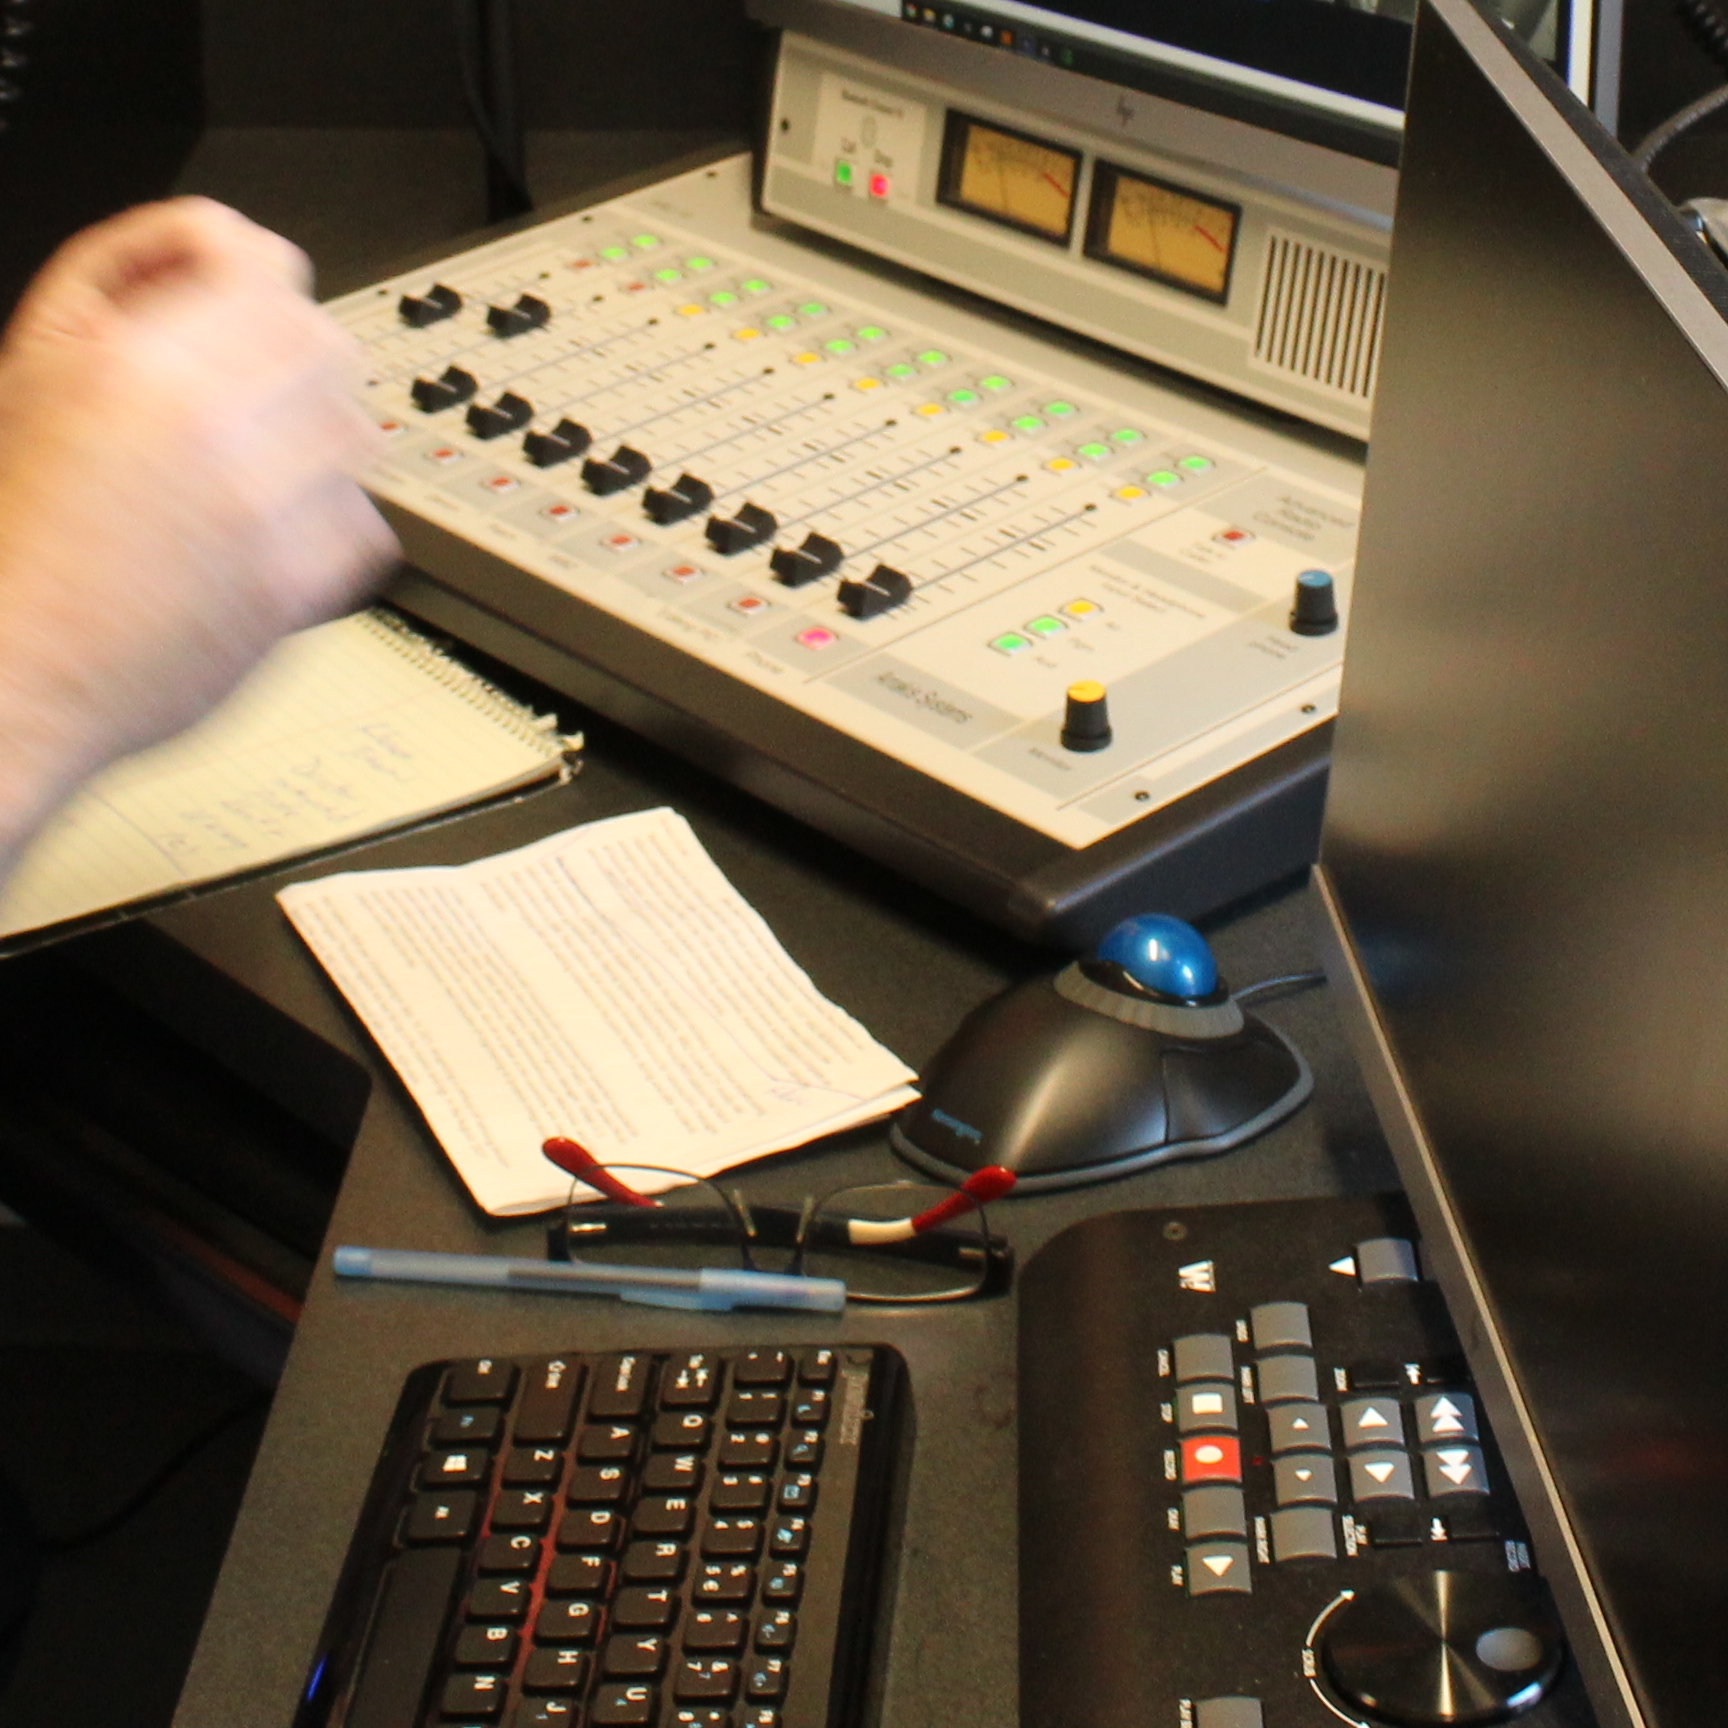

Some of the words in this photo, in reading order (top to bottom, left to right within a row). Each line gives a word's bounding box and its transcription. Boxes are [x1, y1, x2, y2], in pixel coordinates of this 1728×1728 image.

[1157, 1349, 1170, 1377] CANCEL
[1334, 1368, 1347, 1391] ZOOM
[1160, 1403, 1172, 1423] STOP
[683, 1414, 702, 1428] Q
[610, 1427, 629, 1439] A
[534, 1450, 554, 1461] Z
[674, 1455, 694, 1471] W
[1163, 1450, 1177, 1480] RECORD
[600, 1468, 620, 1480] S
[523, 1492, 543, 1505] X
[666, 1498, 686, 1510] E
[590, 1511, 610, 1525] D
[511, 1536, 531, 1548] C
[1342, 1516, 1357, 1556] SELECTION
[656, 1544, 676, 1556] R
[579, 1557, 600, 1567] F
[1170, 1565, 1183, 1586] PLAY
[500, 1582, 520, 1594] V
[647, 1590, 667, 1602] T
[569, 1603, 589, 1617] G
[487, 1628, 507, 1640] B
[637, 1638, 657, 1652] Y
[557, 1651, 578, 1663] H
[1301, 1649, 1315, 1676] SCRUB
[474, 1676, 495, 1689] N
[626, 1686, 646, 1700] U
[545, 1701, 566, 1712] J
